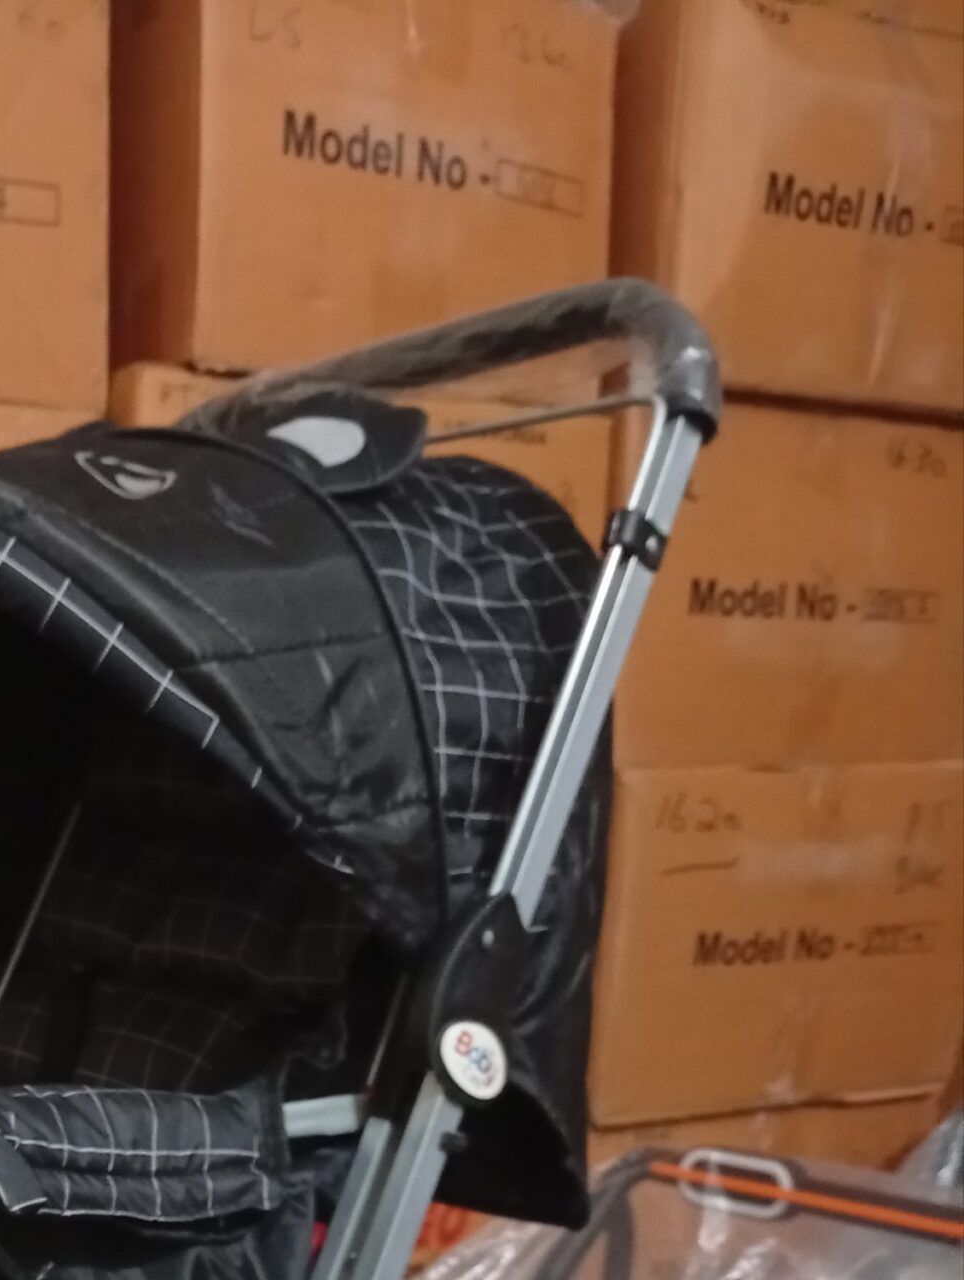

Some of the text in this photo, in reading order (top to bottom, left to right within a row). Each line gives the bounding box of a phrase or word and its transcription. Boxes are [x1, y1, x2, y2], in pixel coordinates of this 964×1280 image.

[282, 108, 405, 178] Model
[417, 136, 468, 191] No
[763, 170, 865, 231] Model
[871, 191, 914, 238] No
[688, 576, 788, 620] Model
[794, 582, 838, 622] No
[692, 928, 788, 966] Model
[793, 928, 836, 962] No
